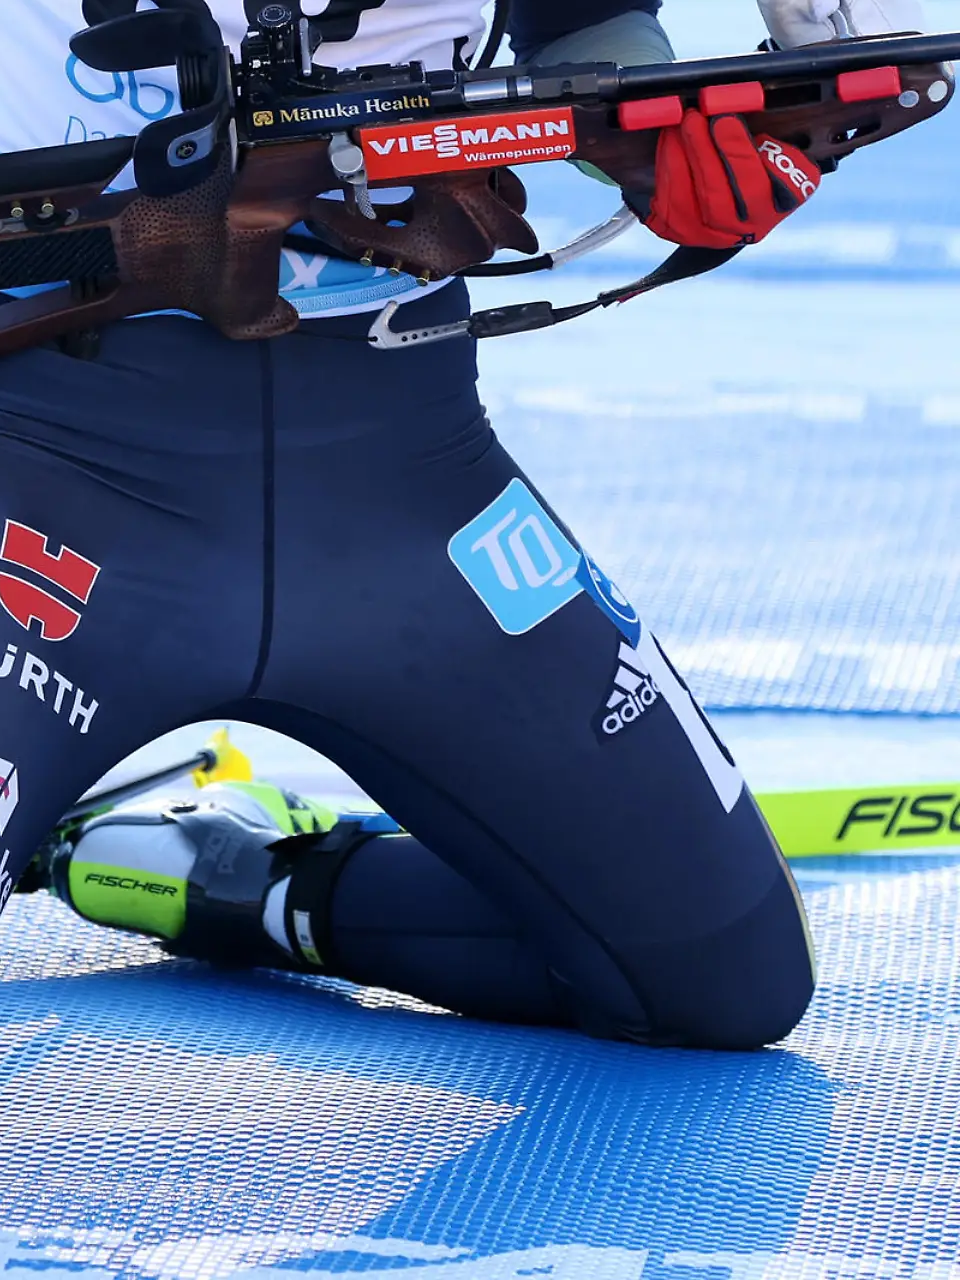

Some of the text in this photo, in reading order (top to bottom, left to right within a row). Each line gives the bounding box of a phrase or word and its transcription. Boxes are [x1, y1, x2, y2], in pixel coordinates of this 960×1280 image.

[279, 95, 431, 123] Mānuka Health
[463, 144, 572, 163] Wärmepumpen
[84, 872, 179, 897] FISCHER
